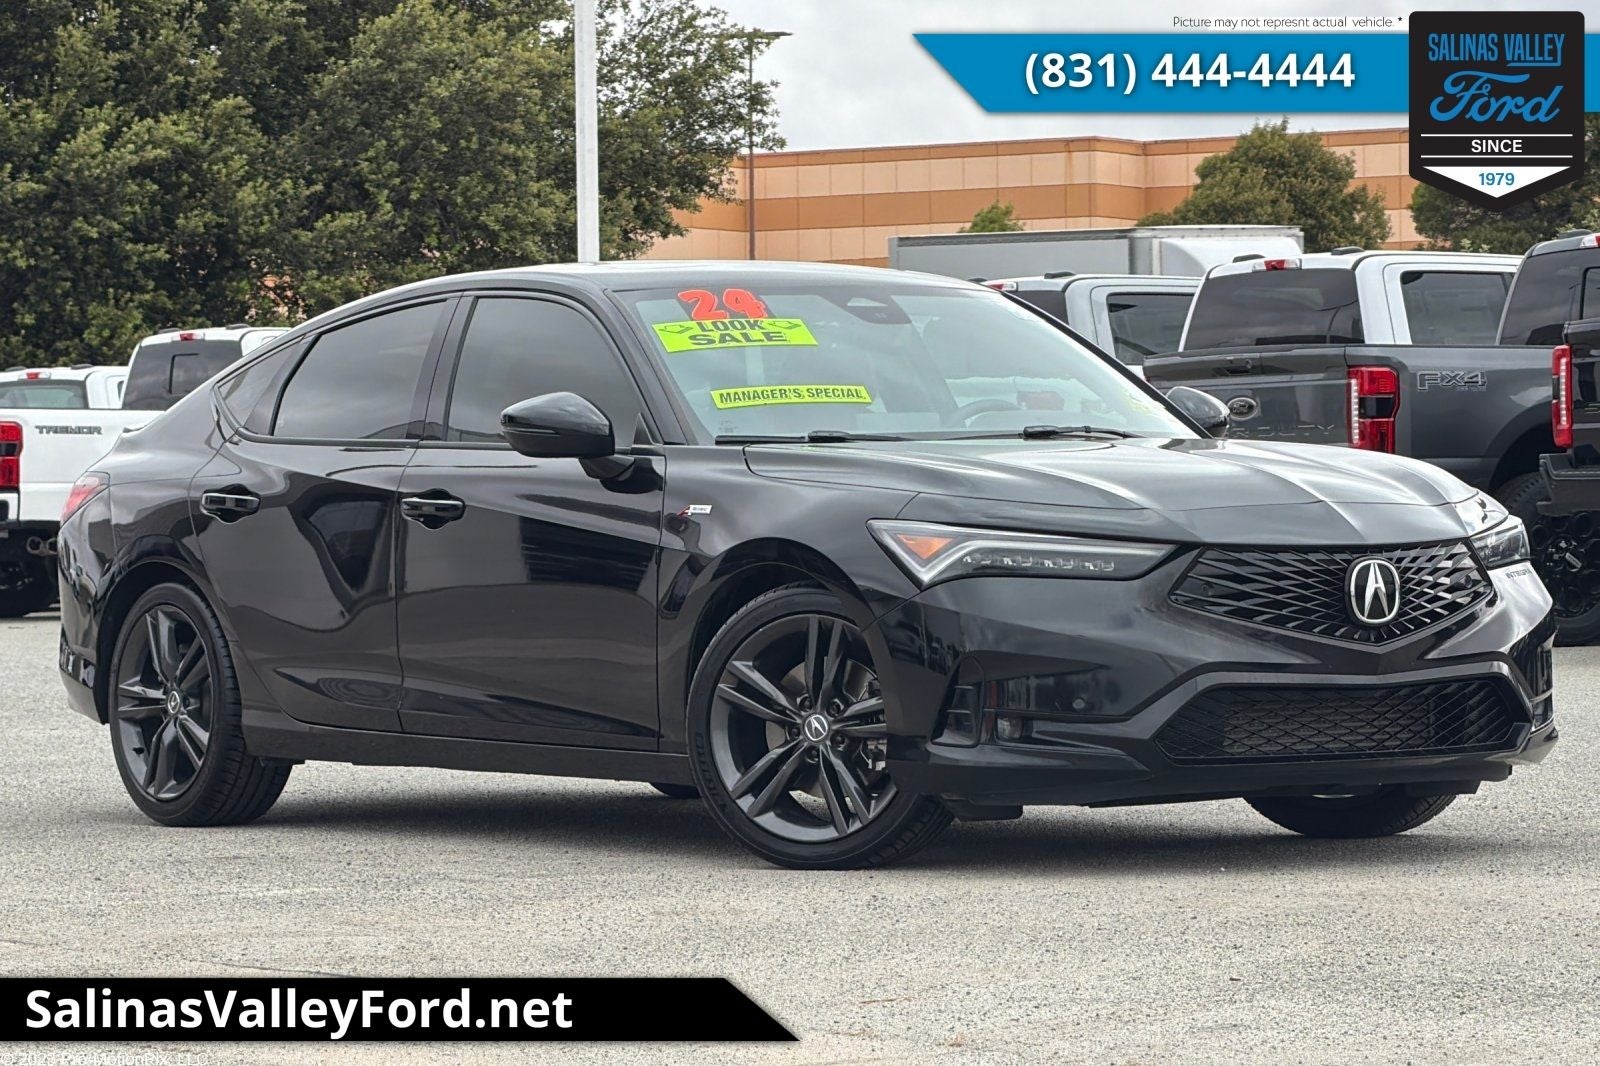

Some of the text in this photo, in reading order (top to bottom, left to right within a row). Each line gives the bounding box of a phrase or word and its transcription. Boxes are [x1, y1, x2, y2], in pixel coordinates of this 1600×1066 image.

[677, 288, 769, 321] 24
[695, 319, 767, 333] LOOK
[688, 331, 788, 346] SALE
[1416, 370, 1488, 391] FX4
[719, 387, 802, 404] MANAGER'S
[34, 424, 103, 436] TREMOR
